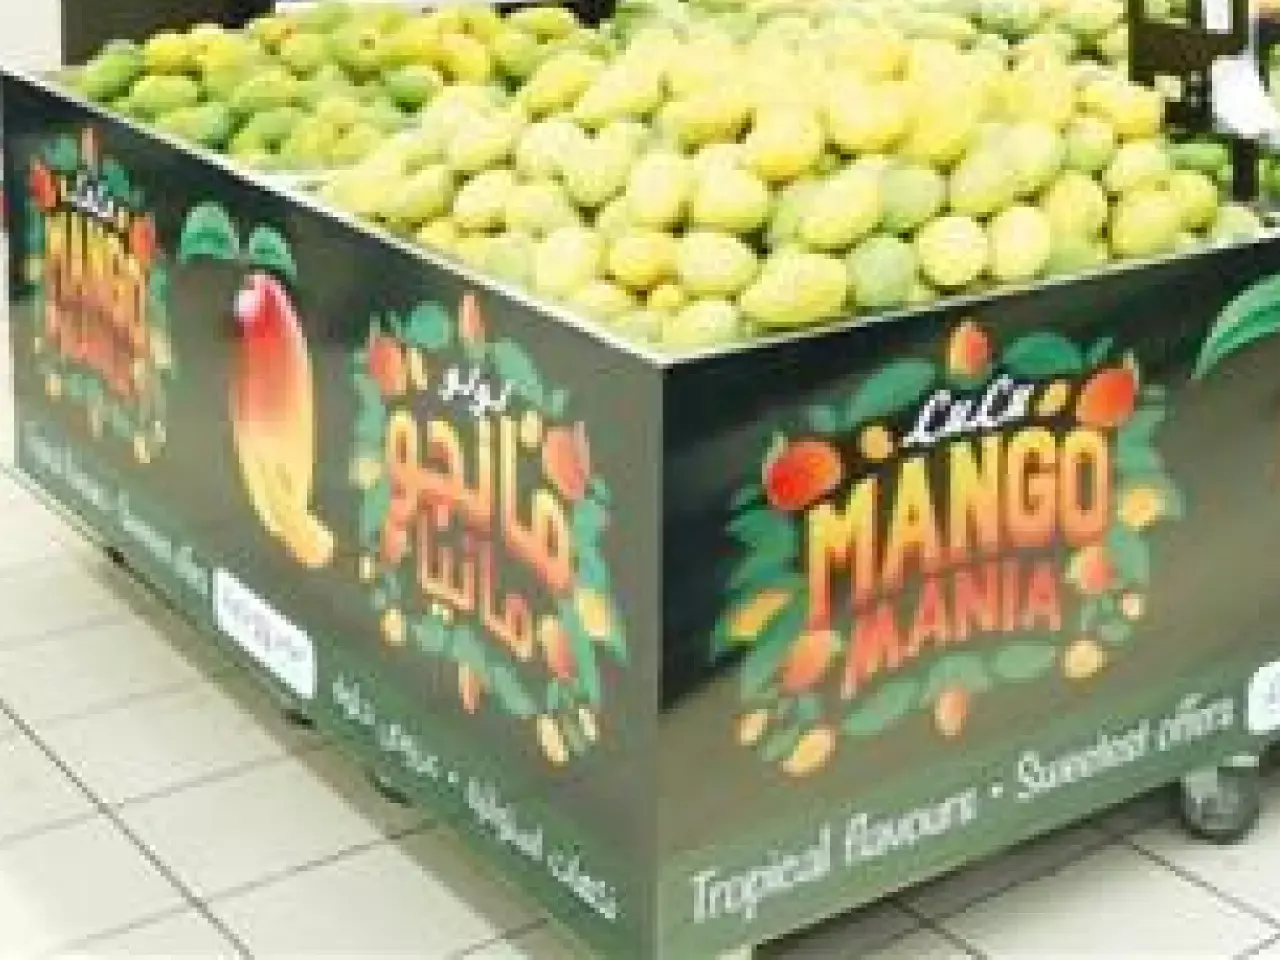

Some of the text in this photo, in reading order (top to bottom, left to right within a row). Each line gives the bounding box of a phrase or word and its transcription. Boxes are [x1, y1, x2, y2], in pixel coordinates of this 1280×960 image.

[806, 428, 1112, 630] MANGO
[841, 556, 1062, 700] MANIA
[690, 688, 1236, 924] Tropical flavours Sweetest offers
